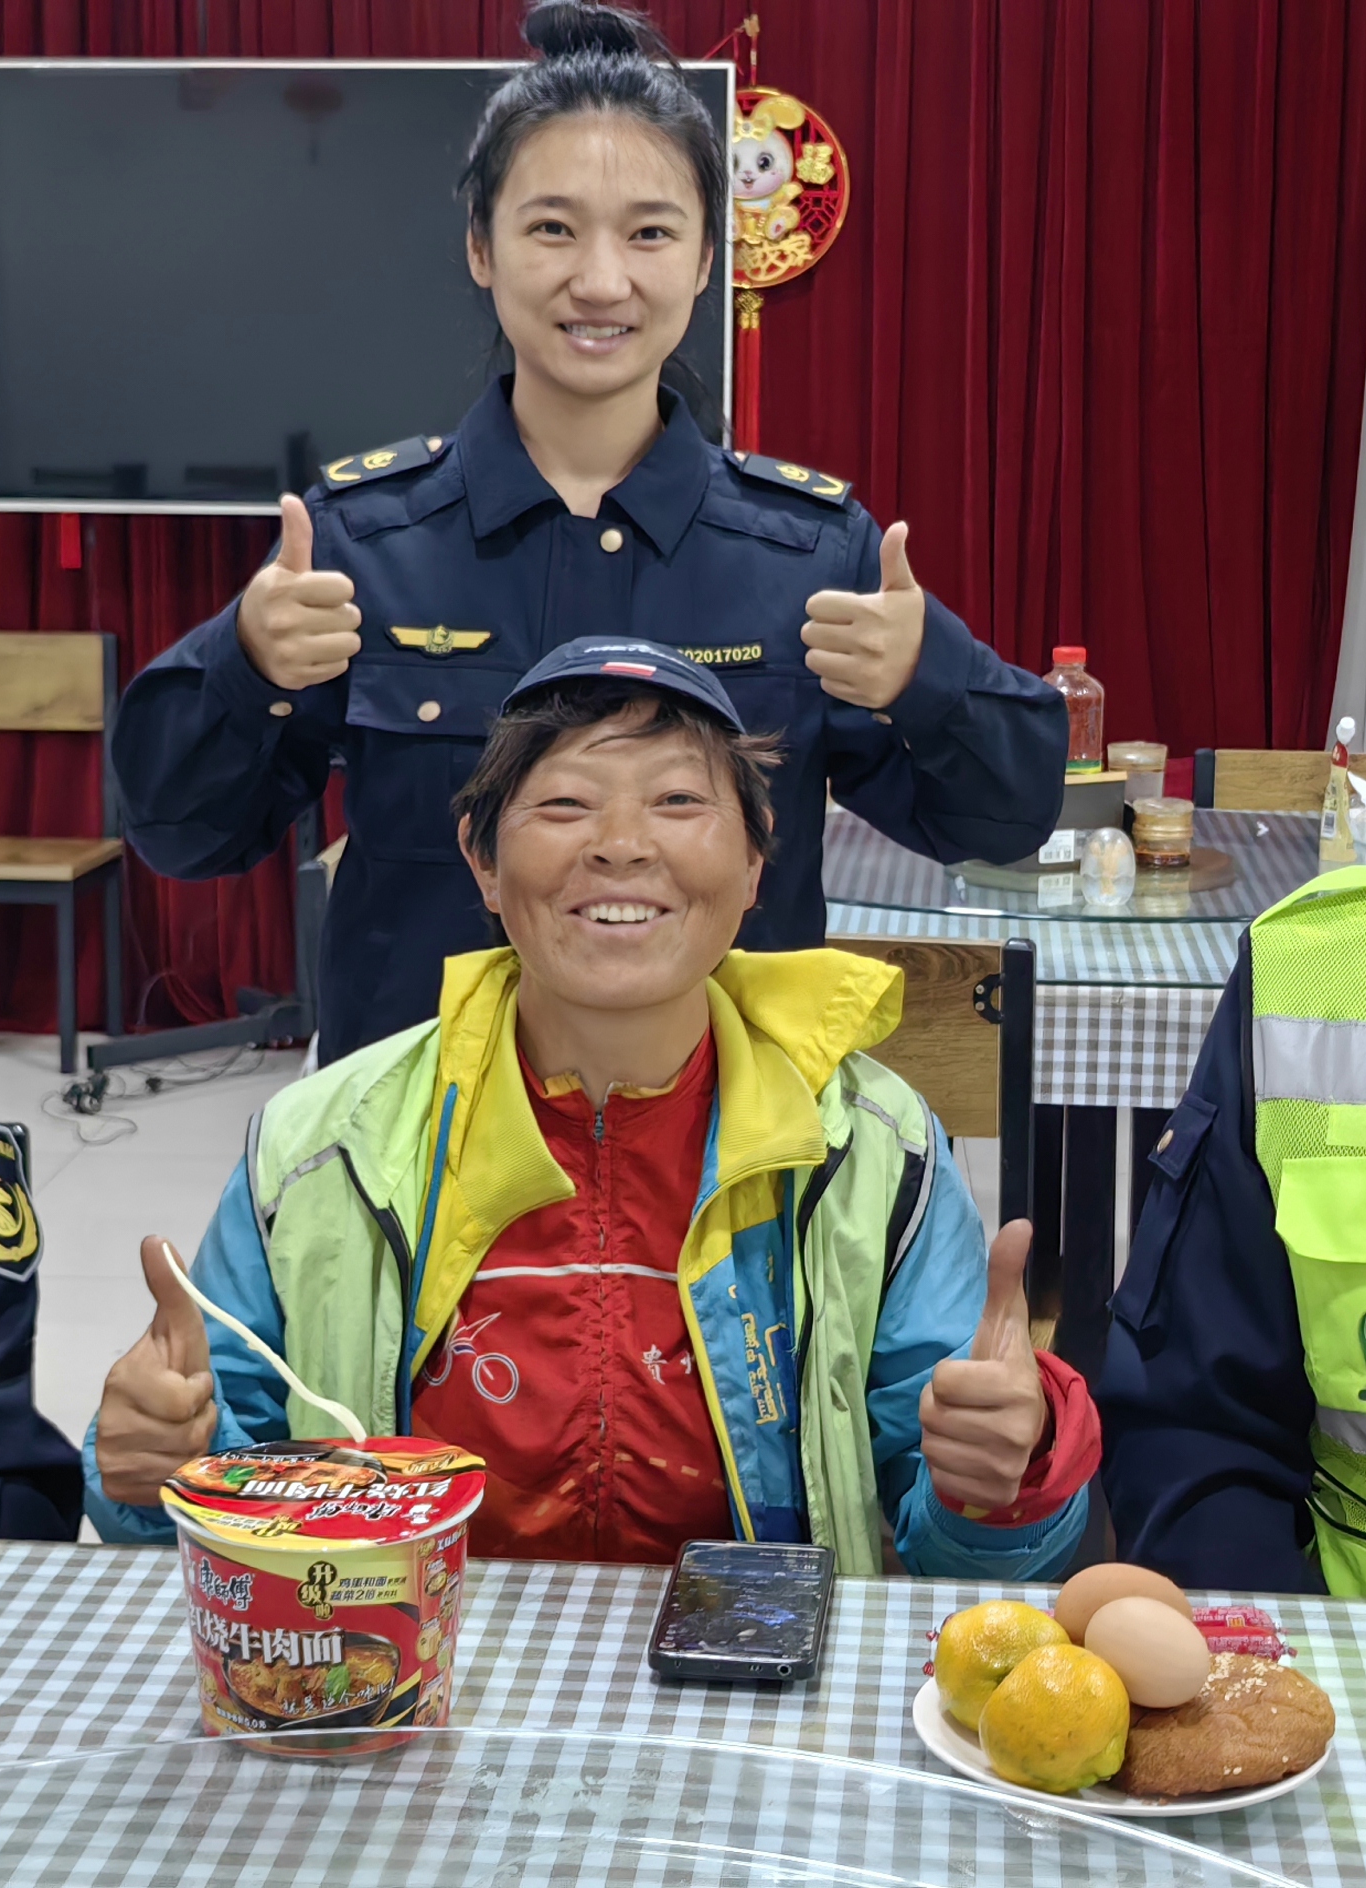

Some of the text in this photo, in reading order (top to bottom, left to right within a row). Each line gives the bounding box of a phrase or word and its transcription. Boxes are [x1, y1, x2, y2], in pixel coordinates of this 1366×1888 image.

[678, 645, 762, 664] 02017020
[241, 1478, 452, 1499] 红烧牛肉面
[189, 1600, 343, 1667] 红烧牛肉面
